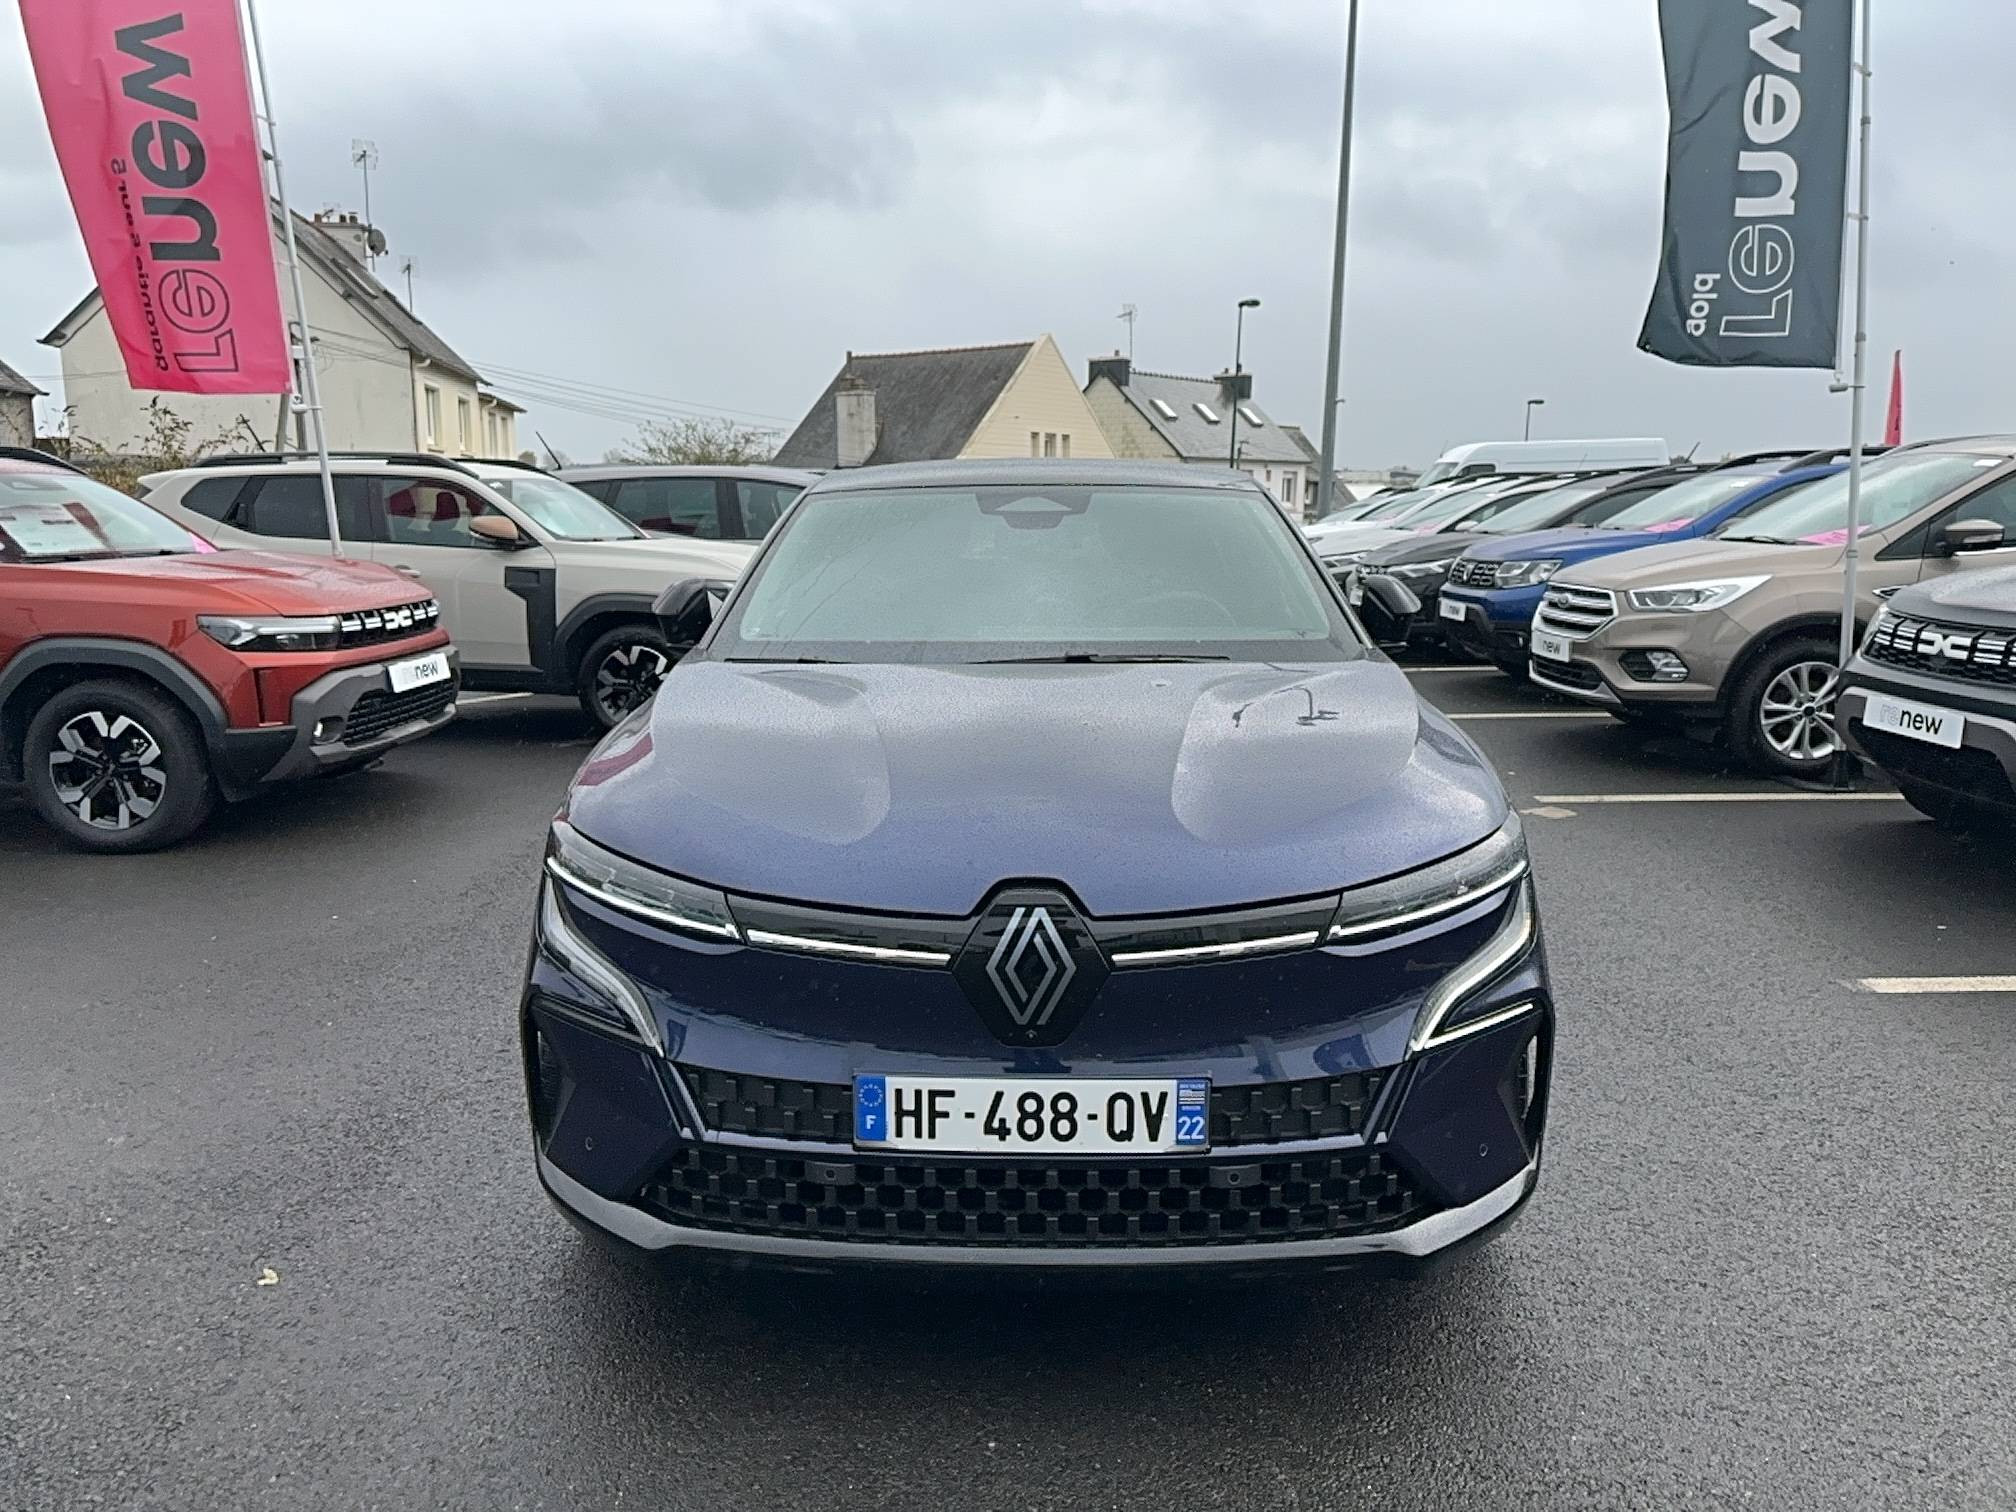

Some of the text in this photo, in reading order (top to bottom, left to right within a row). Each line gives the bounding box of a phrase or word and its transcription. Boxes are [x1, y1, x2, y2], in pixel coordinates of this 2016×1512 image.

[865, 1115, 877, 1130] F
[895, 1088, 1169, 1143] HF-488-QV
[1178, 1116, 1205, 1140] 22
